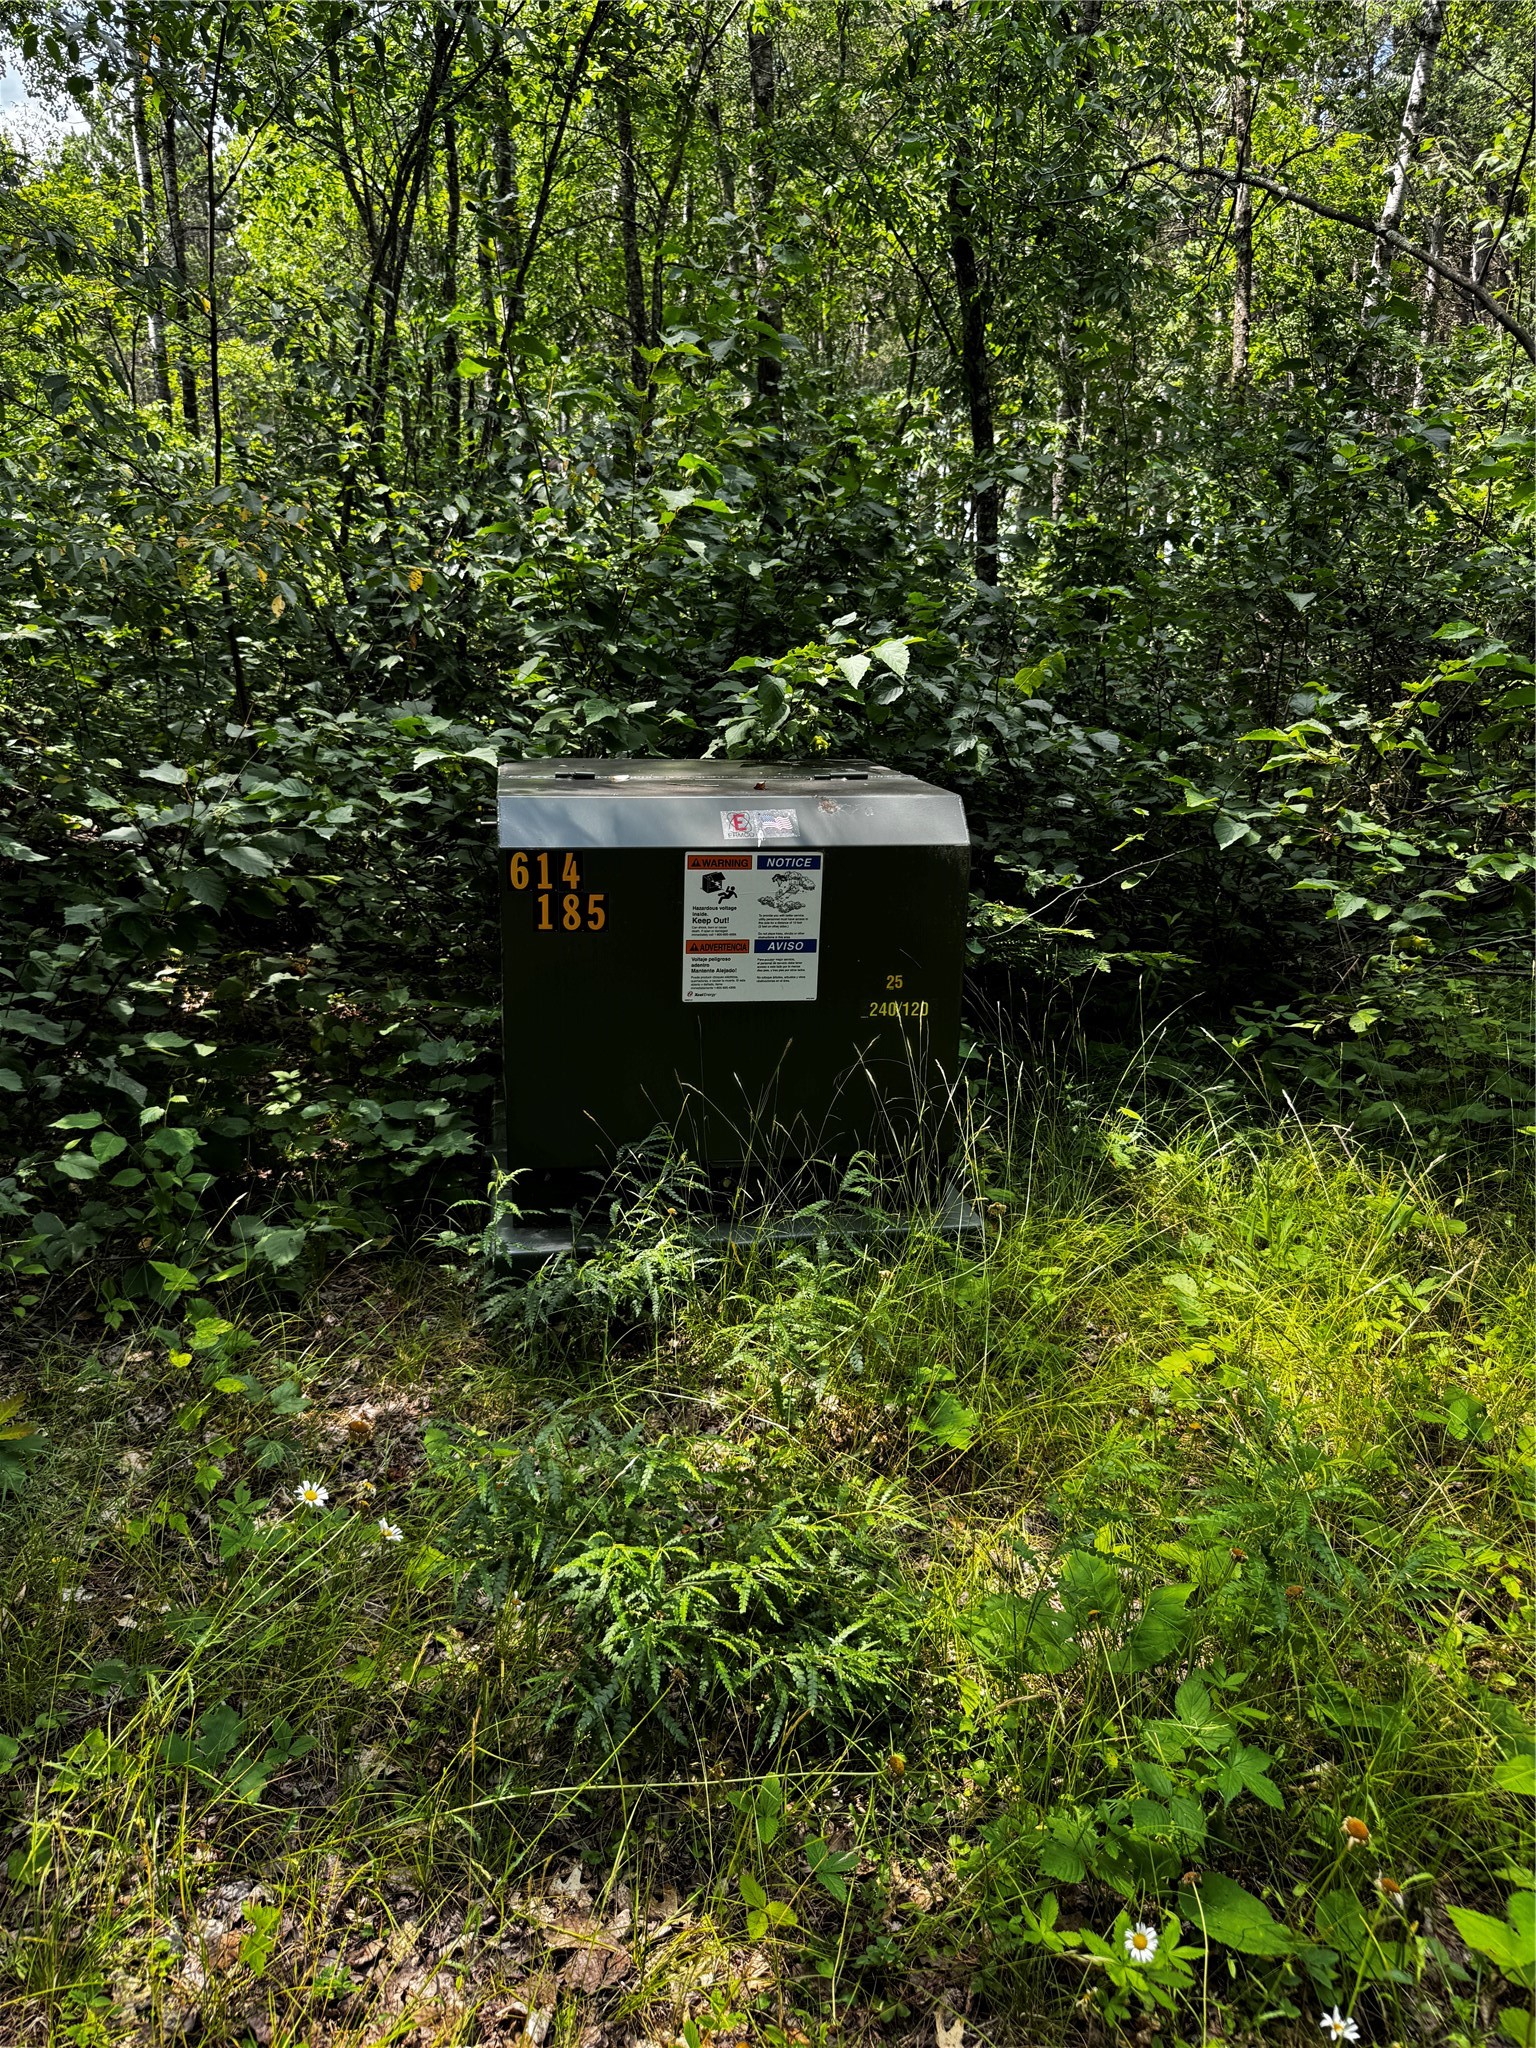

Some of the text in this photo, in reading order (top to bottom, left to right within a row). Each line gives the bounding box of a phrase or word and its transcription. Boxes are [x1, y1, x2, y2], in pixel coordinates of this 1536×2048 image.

[702, 859, 748, 867] WARNING
[767, 858, 812, 867] NOTICE
[510, 852, 580, 889] 614
[538, 894, 605, 930] 185
[692, 917, 711, 925] Keep
[700, 943, 747, 951] ADVERTENCIA
[767, 941, 804, 950] AVISO
[886, 975, 904, 989] 25
[869, 1001, 929, 1017] 240/120
